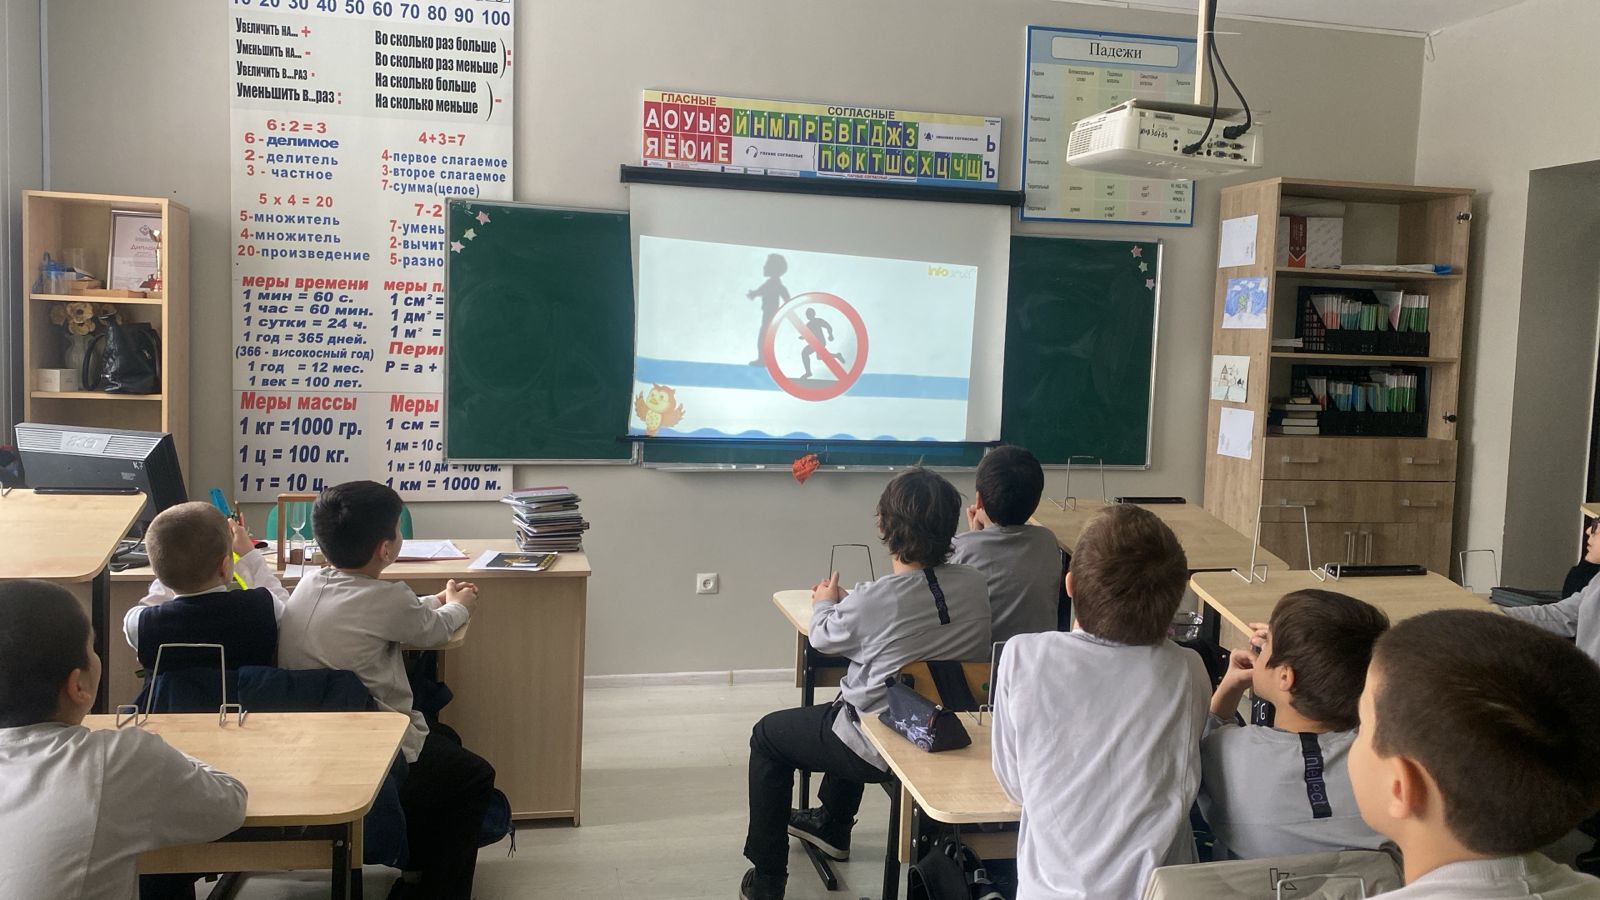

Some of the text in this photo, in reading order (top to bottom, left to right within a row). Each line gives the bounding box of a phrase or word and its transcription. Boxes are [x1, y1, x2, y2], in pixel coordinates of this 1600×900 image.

[316, 0, 337, 12] 40
[345, 0, 365, 15] 50
[372, 2, 392, 17] 60
[400, 3, 420, 19] 70
[428, 6, 447, 21] 80
[454, 8, 474, 24] 90
[482, 10, 510, 26] 100
[375, 30, 497, 54] Во сколько раз больше
[1090, 42, 1142, 59] Падежи
[375, 51, 498, 74] Во сколько раз меньше
[375, 72, 477, 94] На сколько больше
[236, 82, 300, 101] Уменьшить
[661, 92, 716, 106] ГЛАСНЫЕ
[375, 93, 478, 114] На сколько меньше
[827, 106, 896, 120] СОГЛАСНЫЕ
[442, 155, 508, 168] слагаемое
[440, 170, 506, 182] слагаемое
[259, 192, 268, 204] 5
[288, 194, 296, 206] 4
[316, 196, 333, 208] 20
[242, 276, 369, 292] меры времени
[384, 280, 428, 294] меры
[243, 289, 354, 304] 1 мин 60 с.
[243, 302, 374, 316] 1 час 60 мин.
[244, 316, 368, 330] 1 сутки 24 ч.
[244, 331, 368, 346] 1 год 365 дней.
[235, 345, 374, 362] (366 високосный год)
[248, 360, 364, 374] 1 год 12 мес.
[249, 376, 362, 388] 1 век 100 лет.
[240, 392, 358, 414] Меры массы
[390, 394, 439, 417] Меры
[240, 416, 248, 435] 1
[255, 422, 275, 435] кг
[338, 422, 362, 440] гр.
[386, 418, 424, 430] 1 см
[240, 445, 349, 466] 1 ц 100 кг.
[240, 474, 248, 492] 1
[256, 478, 264, 492] т
[286, 474, 308, 492] 10
[400, 480, 421, 491] км
[442, 477, 480, 491] 1000
[484, 480, 502, 491] м.
